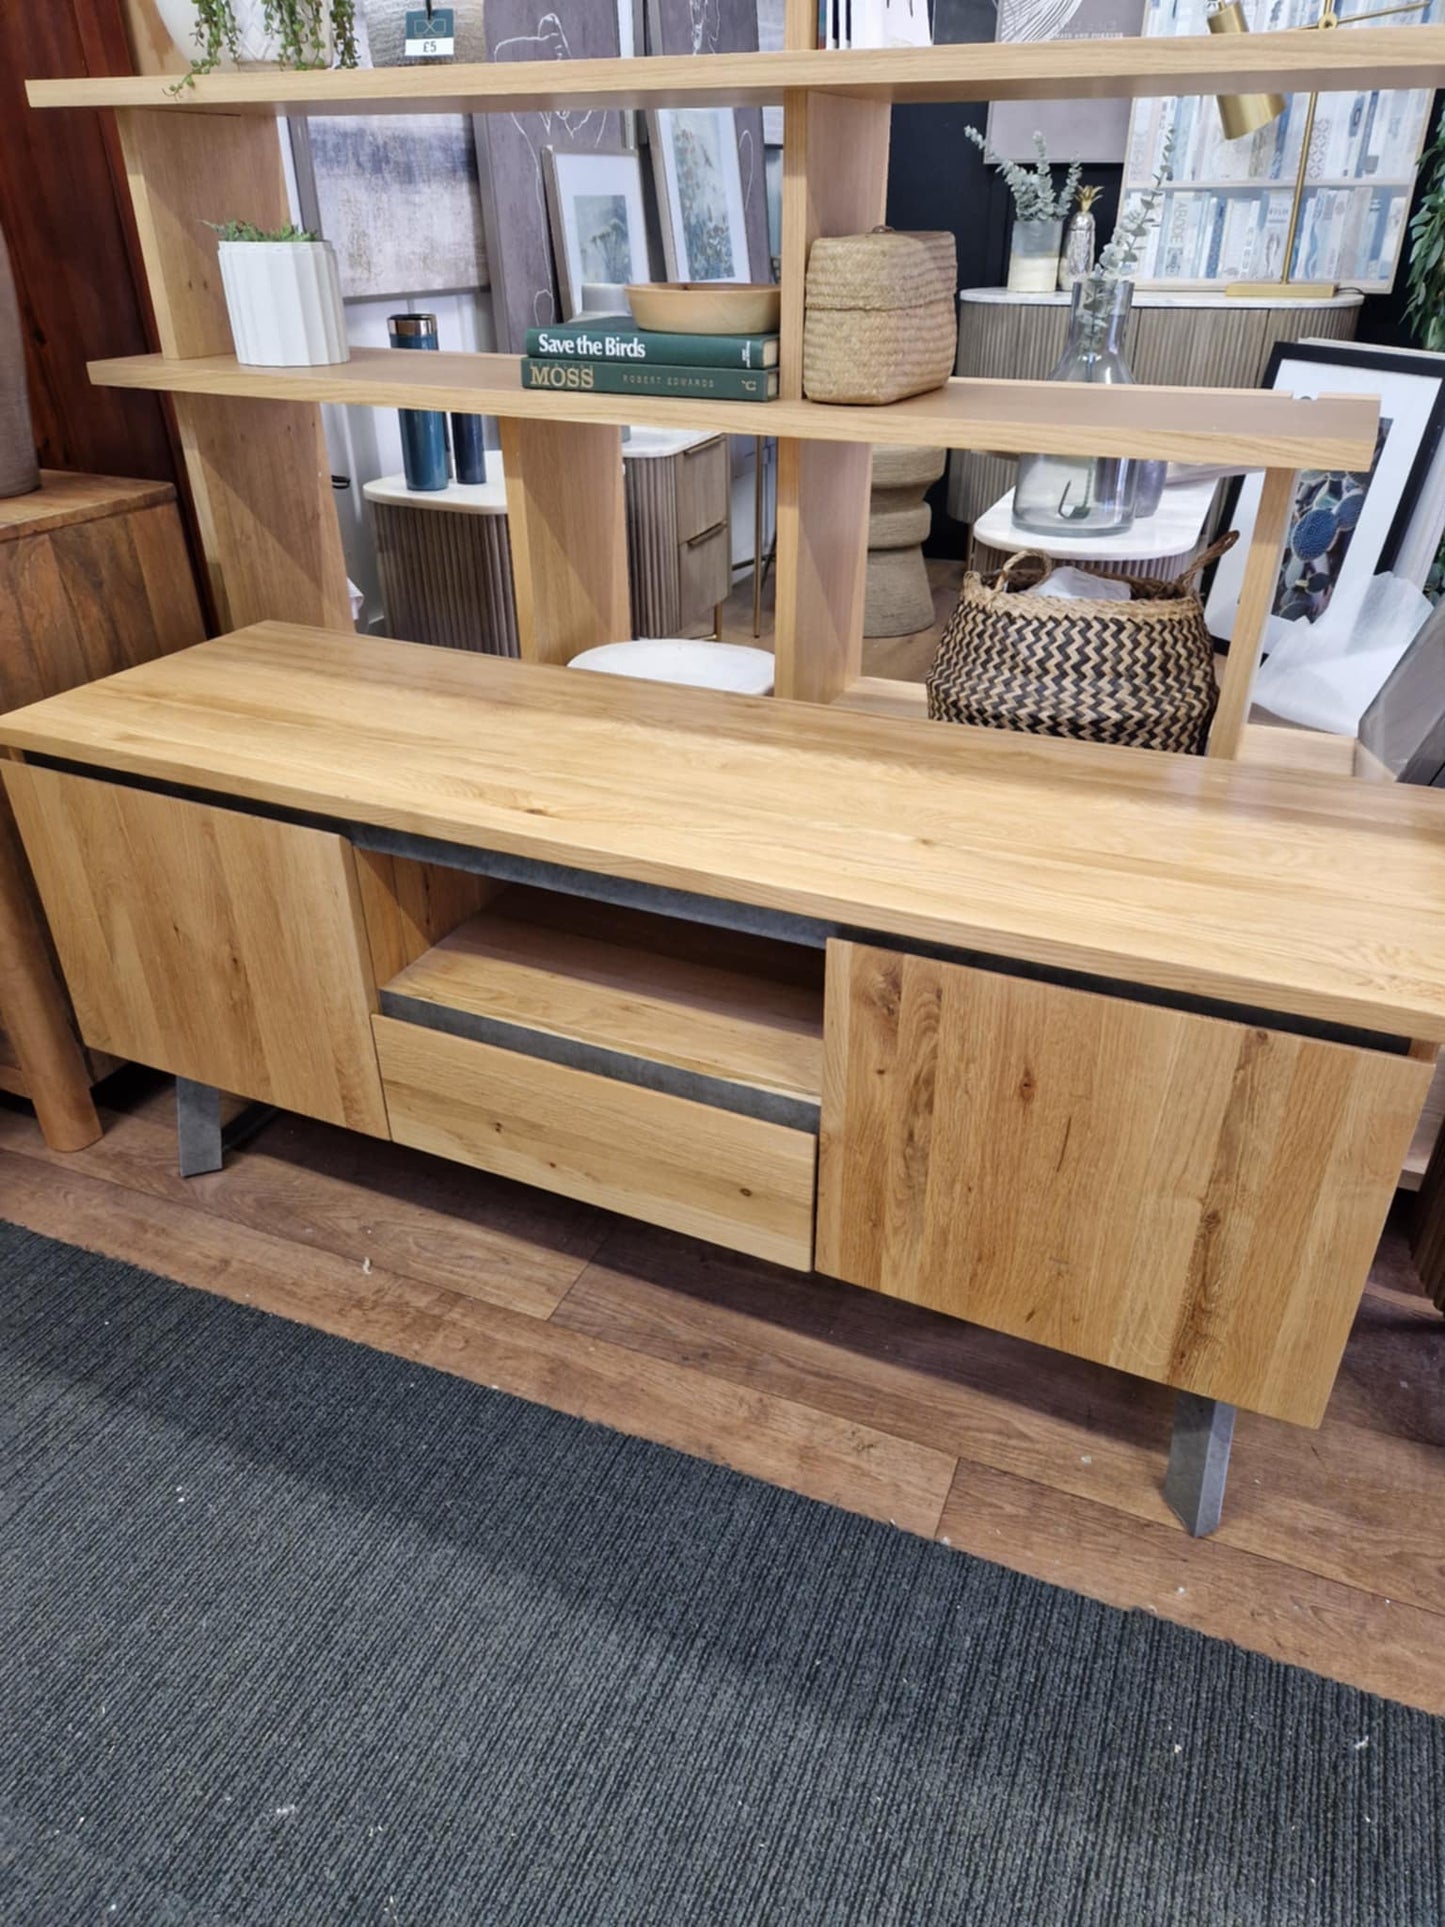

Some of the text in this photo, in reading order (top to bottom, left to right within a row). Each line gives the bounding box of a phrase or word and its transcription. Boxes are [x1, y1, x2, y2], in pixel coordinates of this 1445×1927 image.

[423, 41, 437, 53] £5
[1170, 202, 1188, 244] ABODE
[538, 333, 646, 358] Save the Birds
[530, 365, 594, 388] MOSS
[622, 374, 715, 388] ROBERT EDWARDS
